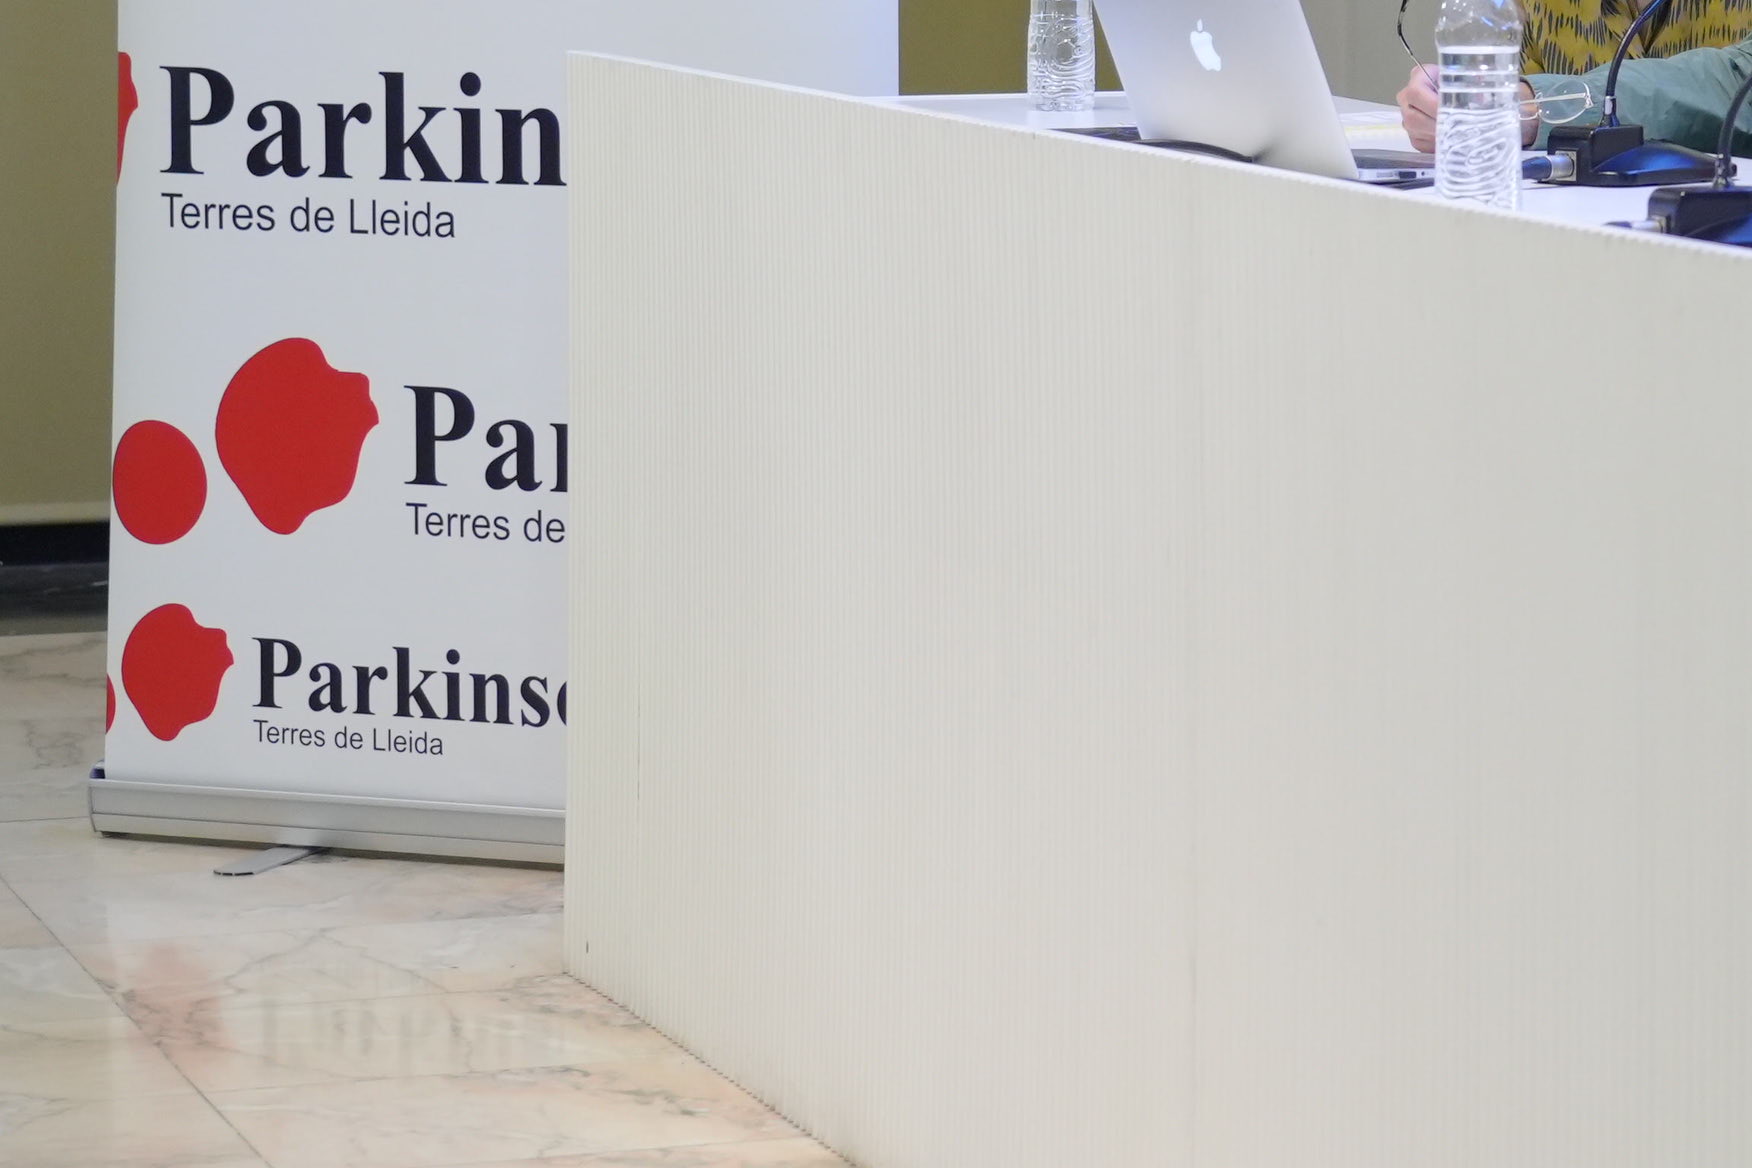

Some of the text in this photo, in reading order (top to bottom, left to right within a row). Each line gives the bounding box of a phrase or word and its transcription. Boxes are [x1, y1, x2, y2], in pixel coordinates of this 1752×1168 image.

[159, 65, 567, 187] Parkin
[160, 192, 455, 238] Terres de Lleida
[405, 502, 565, 544] Terres de
[253, 719, 443, 756] Terres de Lleida
